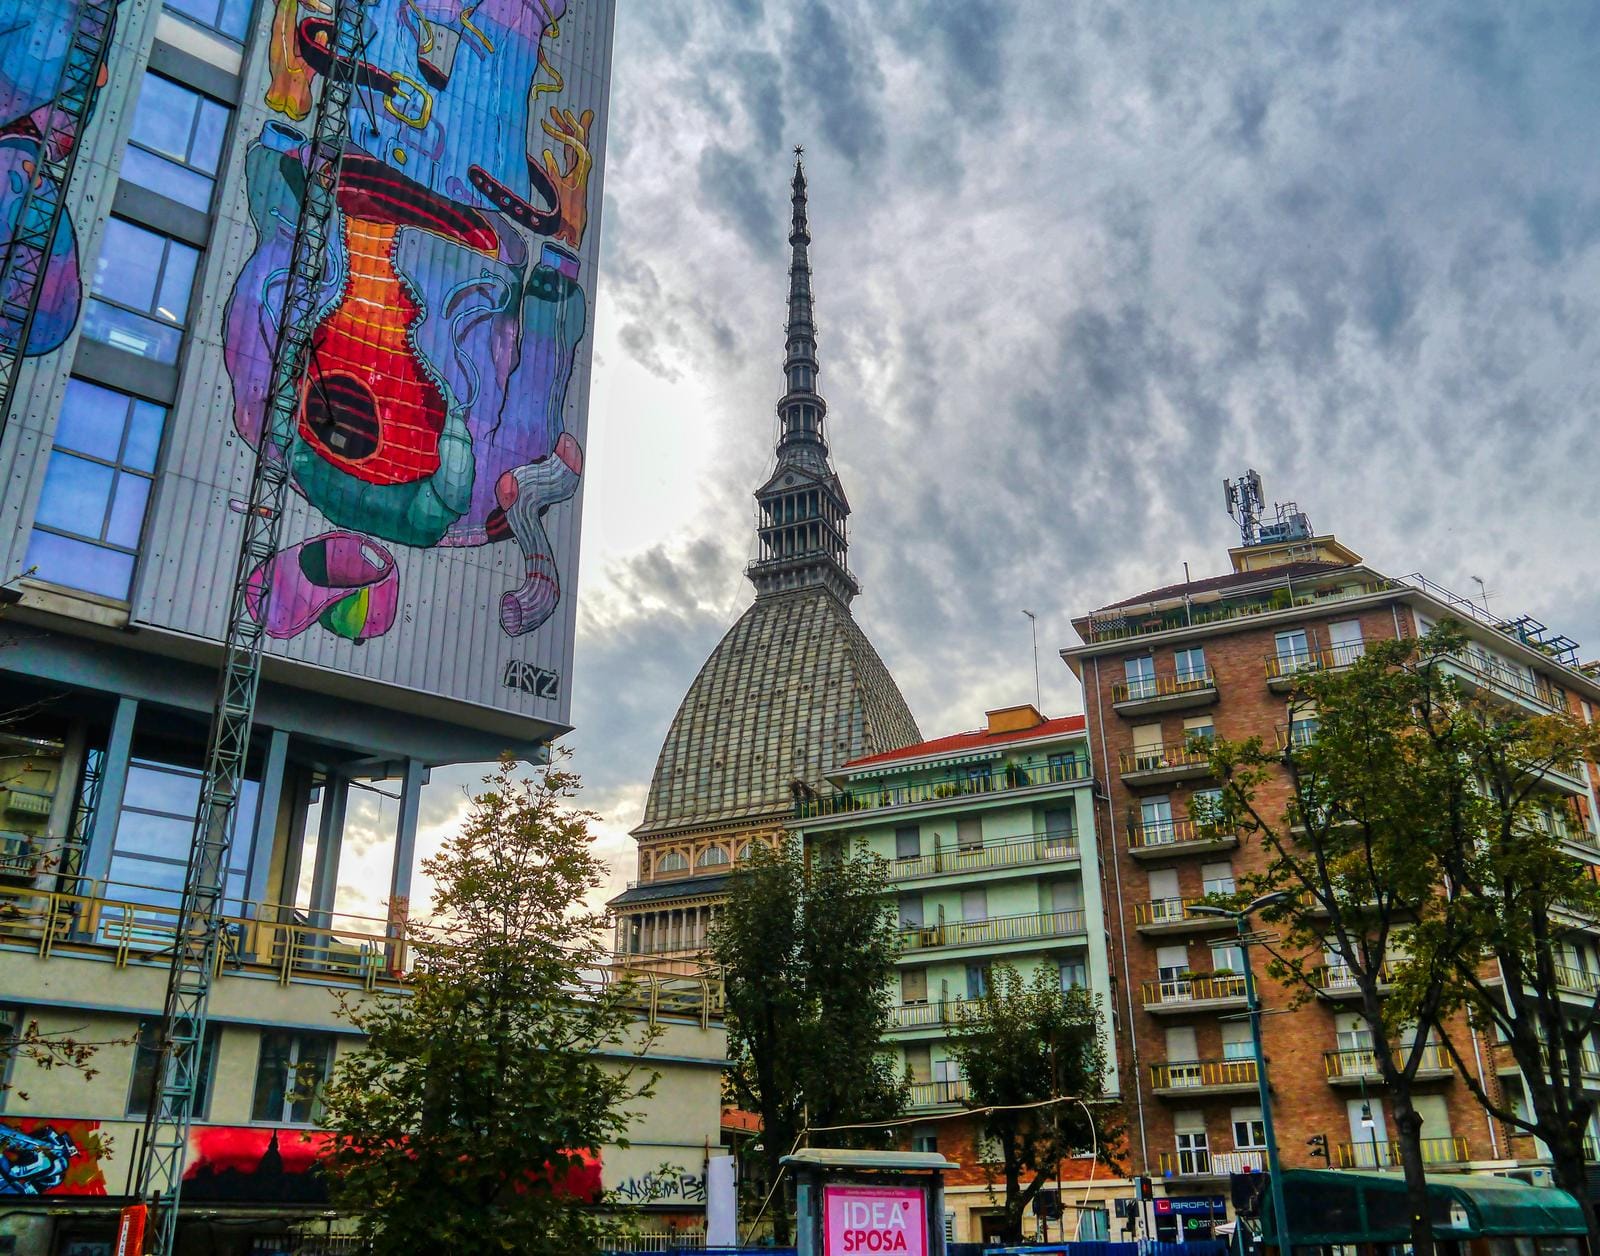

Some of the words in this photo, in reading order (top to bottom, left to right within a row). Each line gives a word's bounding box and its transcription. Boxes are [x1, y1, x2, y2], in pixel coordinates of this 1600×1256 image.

[504, 660, 558, 699] ARYZ
[844, 1201, 906, 1229] IDEA
[843, 1229, 907, 1251] SPOSA
